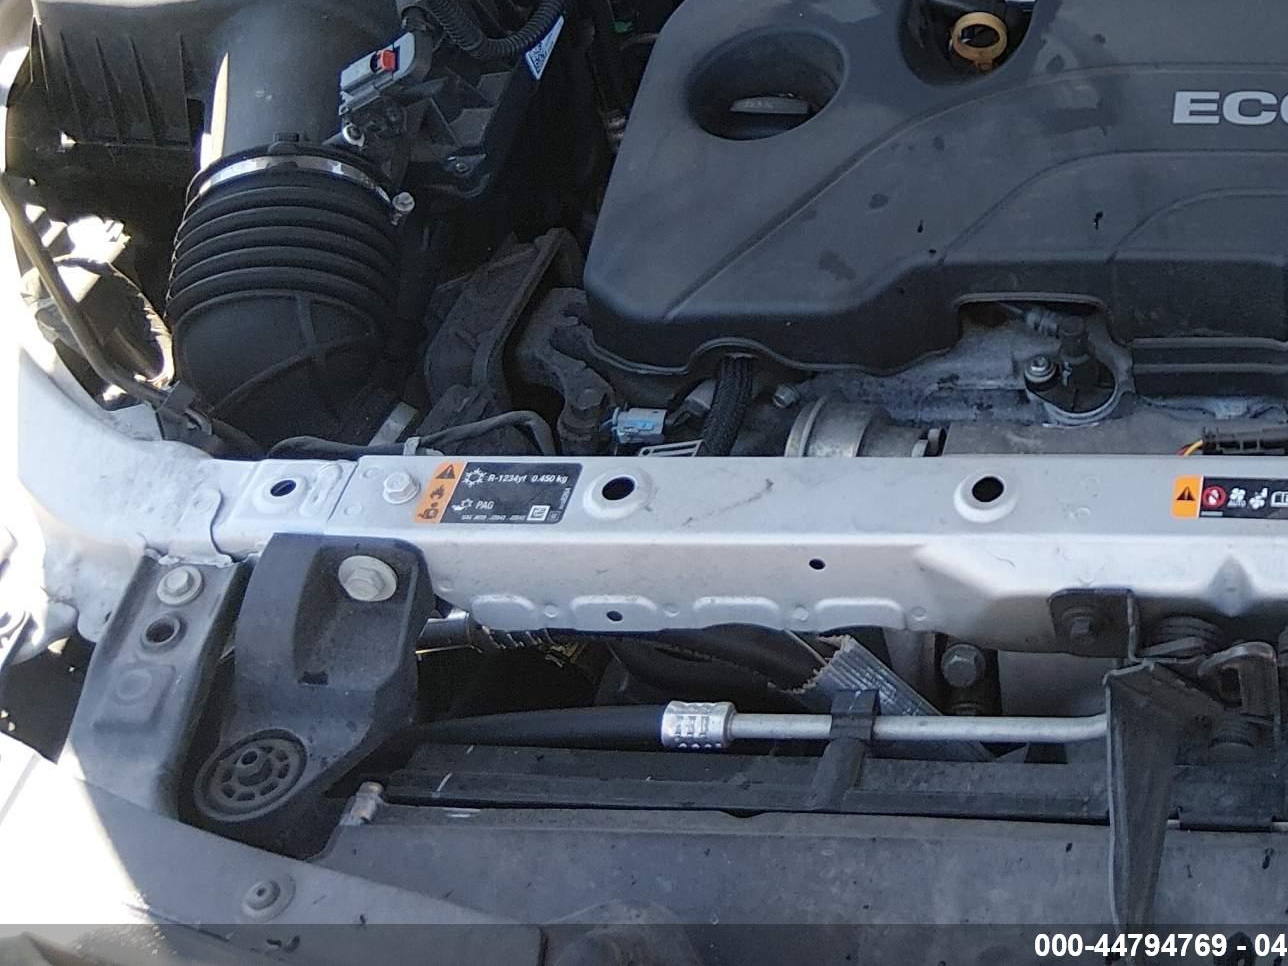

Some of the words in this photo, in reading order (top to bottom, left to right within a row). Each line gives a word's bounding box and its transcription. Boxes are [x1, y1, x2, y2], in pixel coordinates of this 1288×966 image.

[487, 474, 527, 484] R-1234yf
[531, 474, 556, 483] 0.450
[556, 474, 568, 485] kg
[475, 500, 494, 510] PAG
